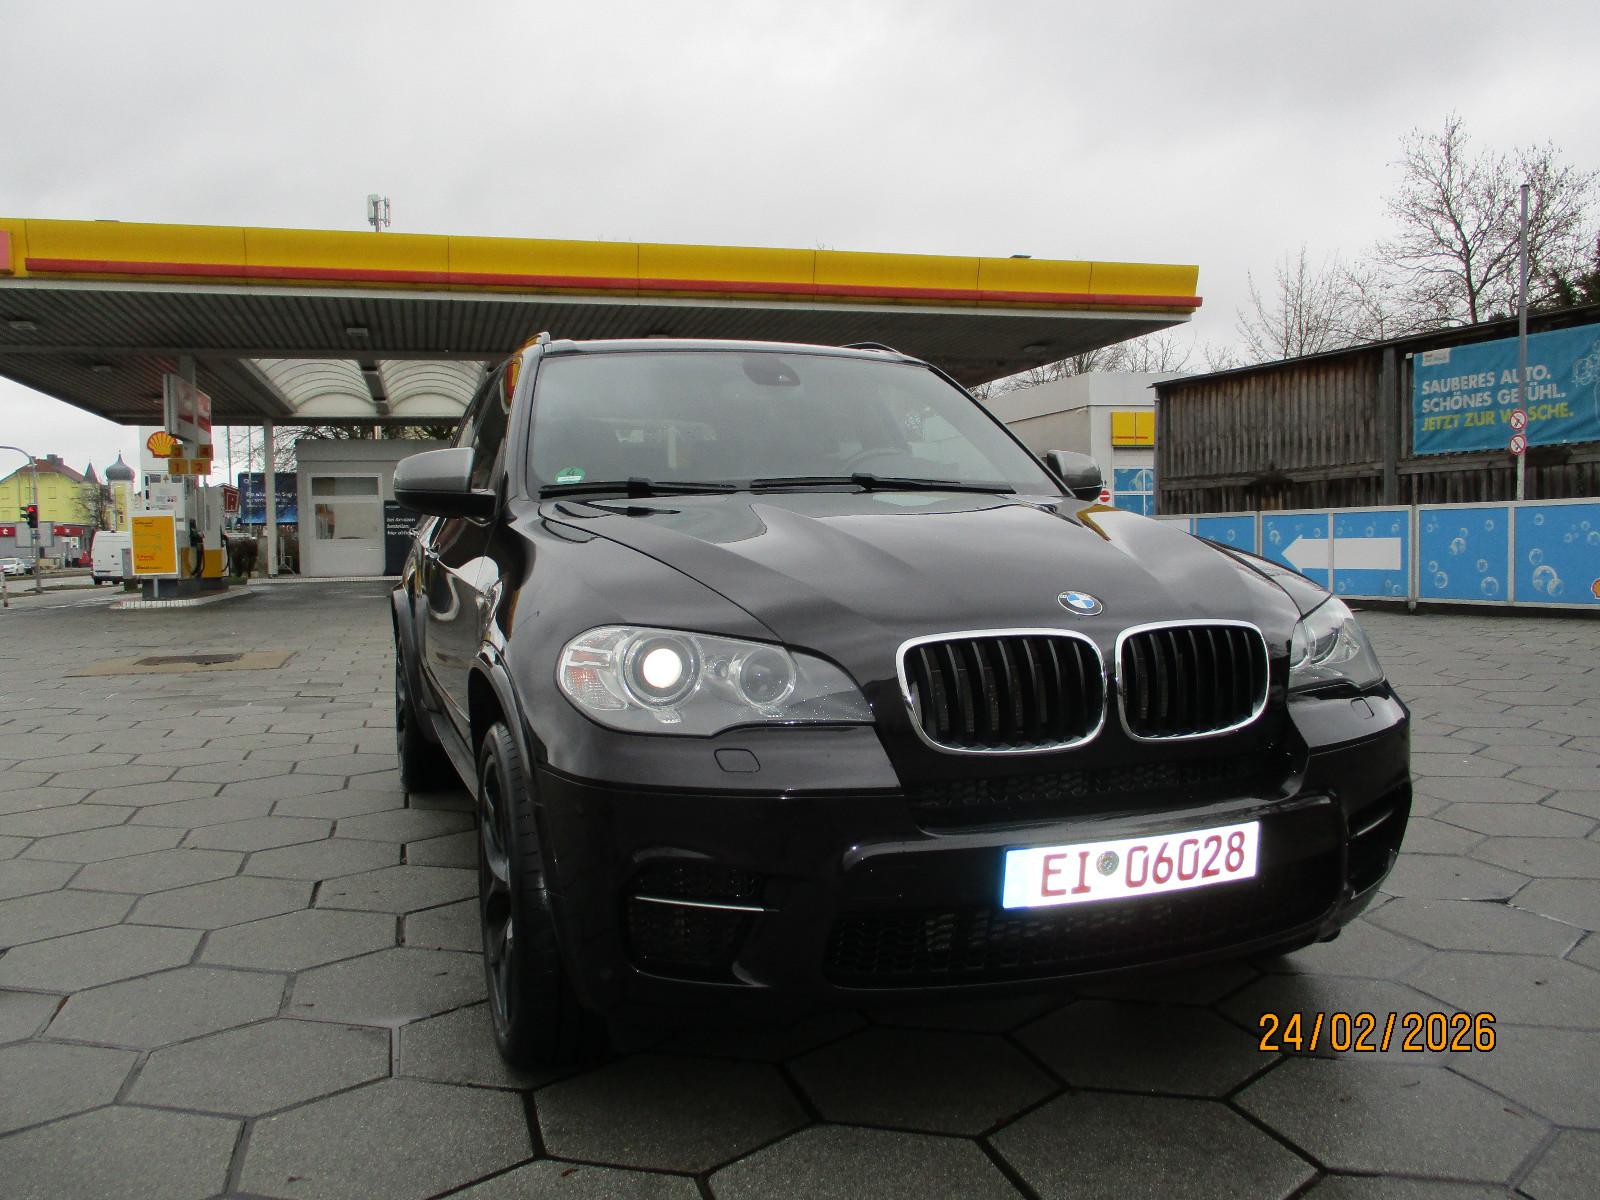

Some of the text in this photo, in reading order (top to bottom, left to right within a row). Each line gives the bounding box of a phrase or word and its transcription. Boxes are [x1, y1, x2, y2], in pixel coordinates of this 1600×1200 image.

[1422, 372, 1495, 395] SAUBERES
[1422, 382, 1566, 413] SCHÖNES GEÜHL.
[1421, 402, 1574, 432] JETZT ZUR WSCHE.
[1040, 831, 1246, 897] EI 06028
